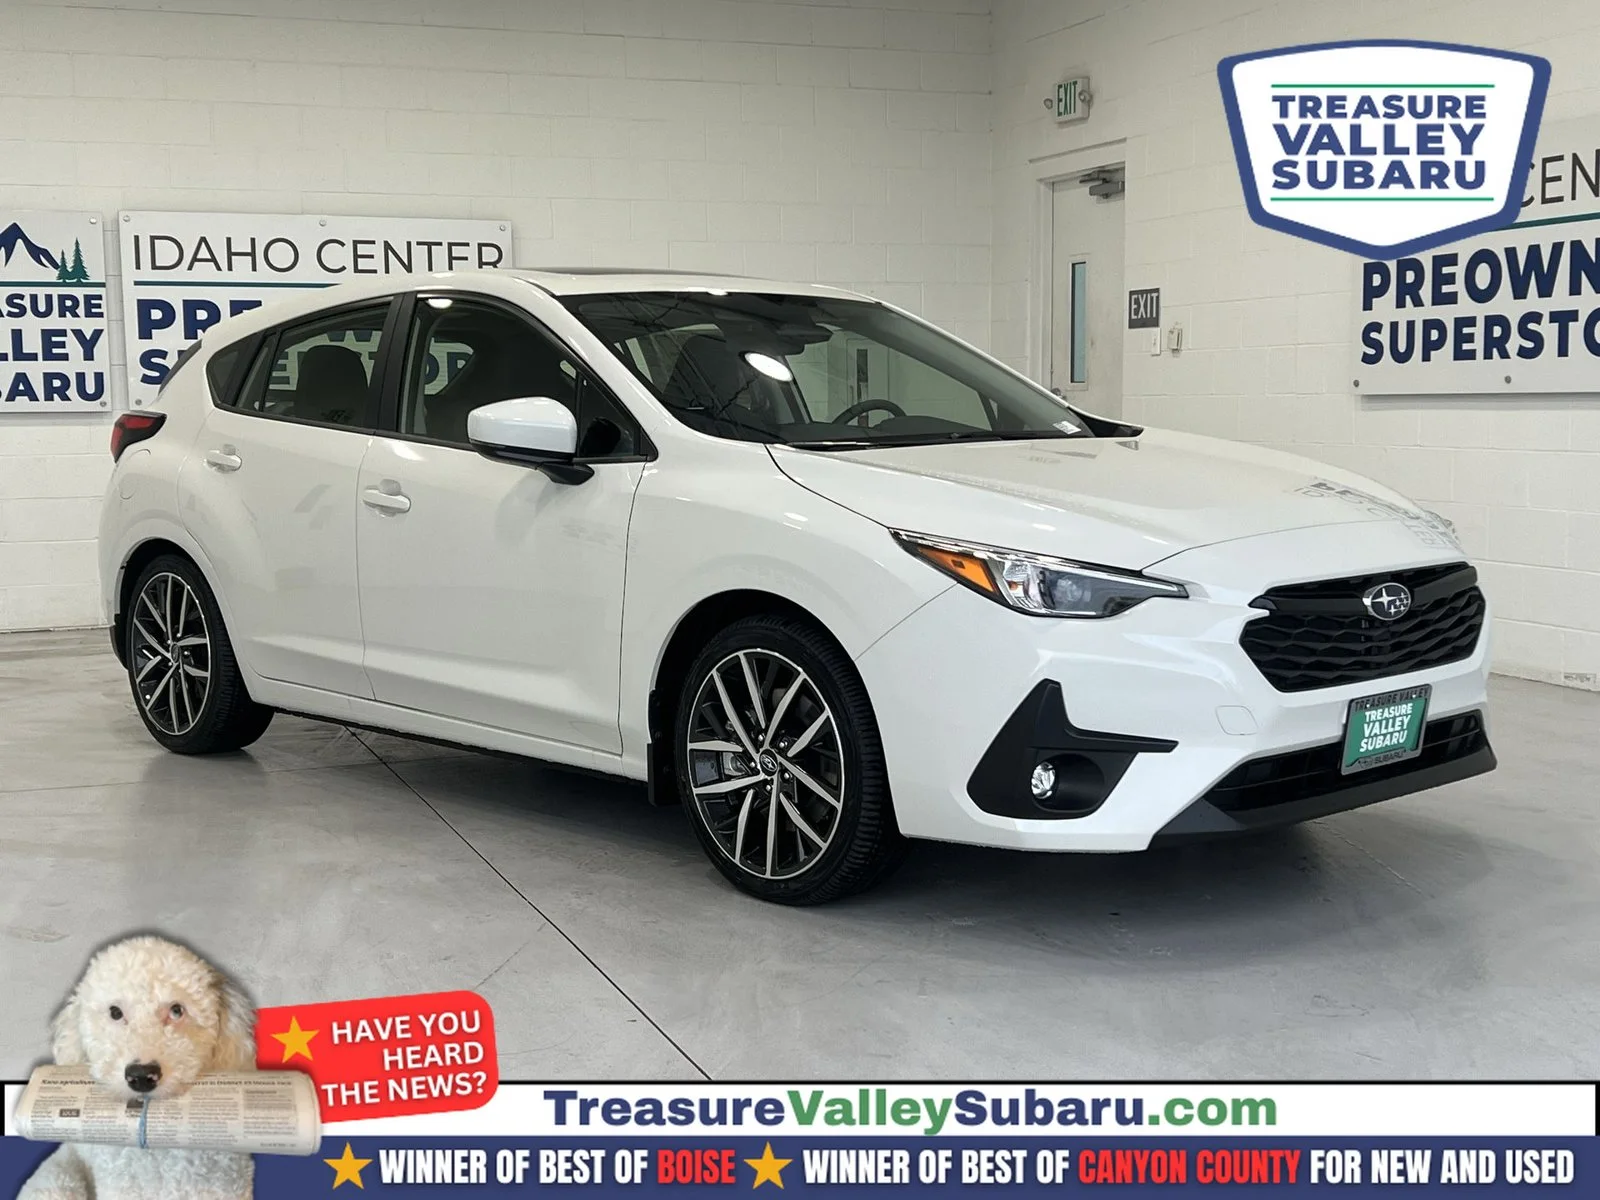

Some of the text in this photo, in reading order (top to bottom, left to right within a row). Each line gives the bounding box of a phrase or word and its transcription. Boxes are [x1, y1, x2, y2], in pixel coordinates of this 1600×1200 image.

[1057, 81, 1078, 117] EXIT
[133, 234, 504, 275] IDAHO CENTER
[0, 293, 105, 319] SURE
[1130, 292, 1159, 320] EXIT
[0, 328, 105, 362] LEY
[0, 371, 105, 402] ARU
[1363, 714, 1412, 738] VALLEY
[1365, 702, 1414, 723] TREASURE
[1359, 730, 1408, 753] SUBARU
